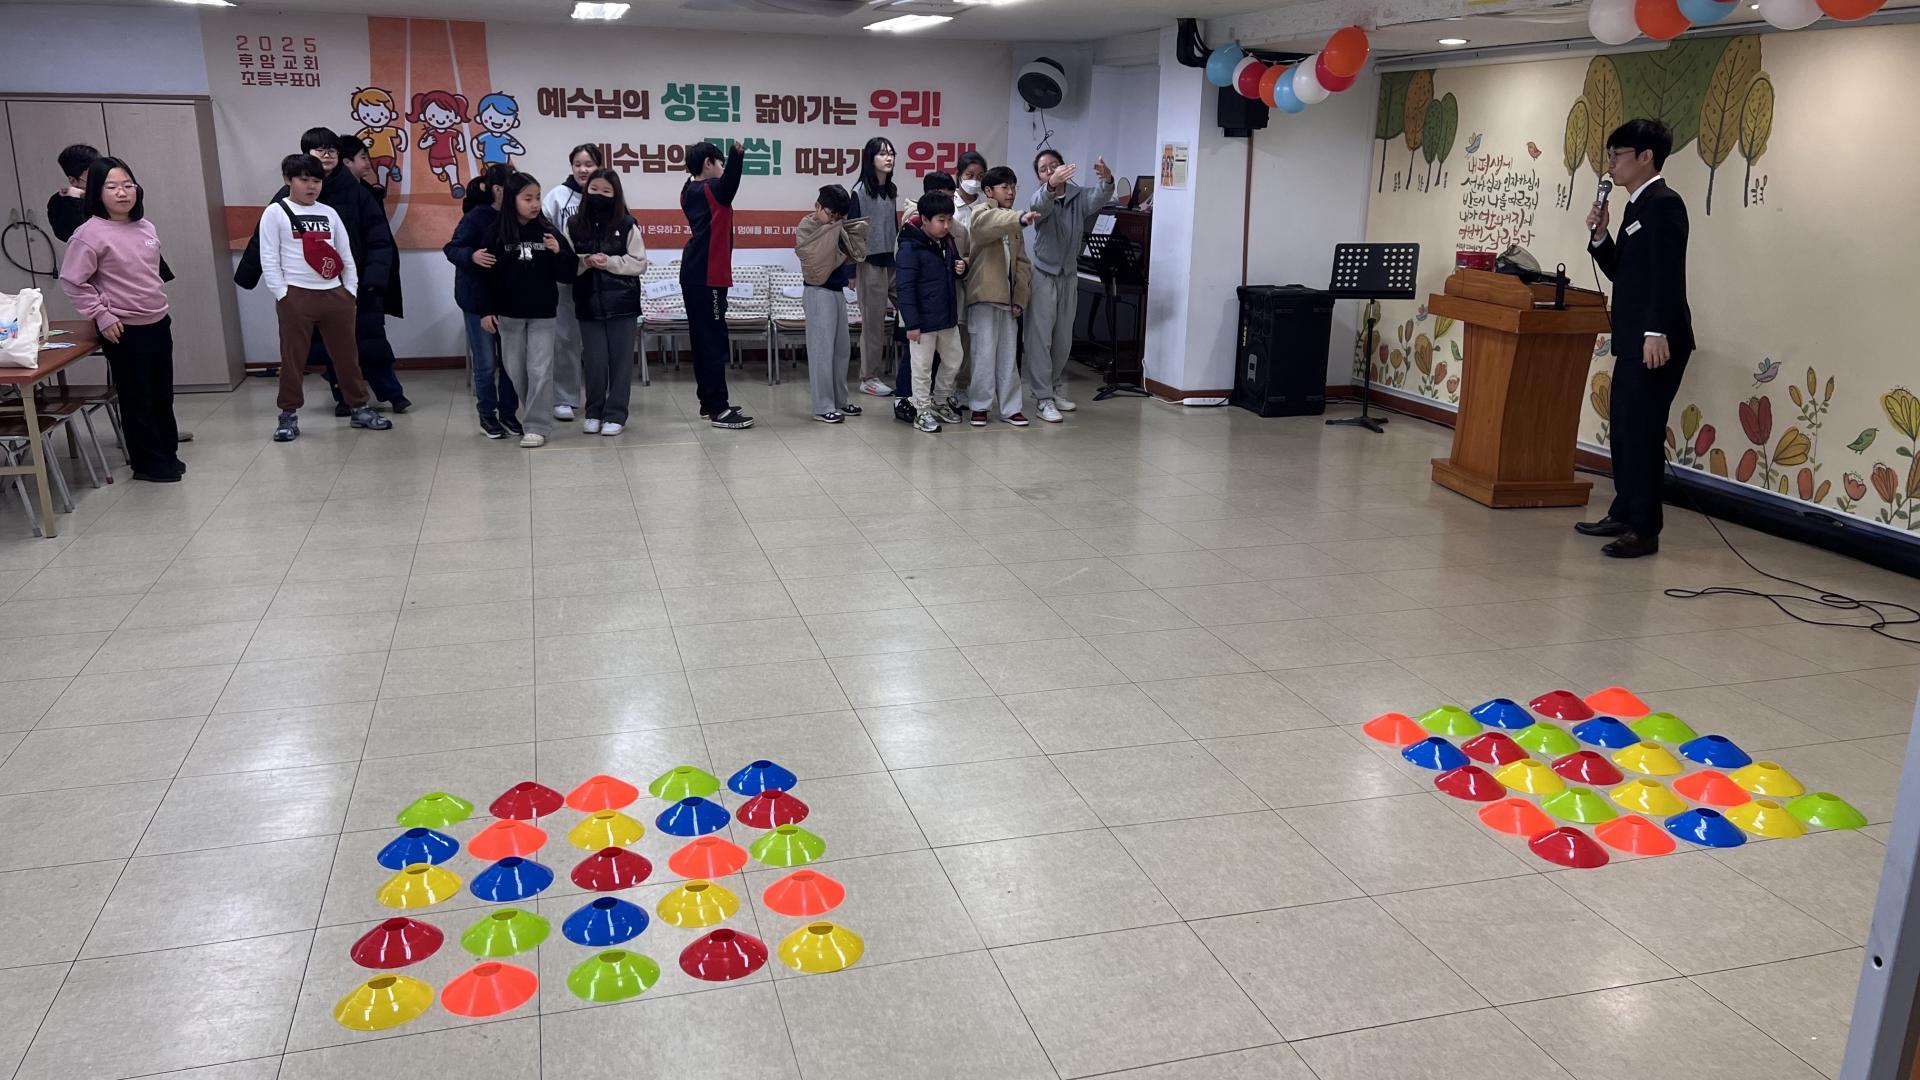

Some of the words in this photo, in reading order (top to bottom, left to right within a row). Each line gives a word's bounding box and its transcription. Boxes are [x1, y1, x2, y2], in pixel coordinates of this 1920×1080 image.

[235, 35, 317, 53] 2025
[238, 53, 319, 70] 후암교회
[241, 71, 320, 87] 초등부표어
[537, 87, 650, 119] 예수님의
[661, 82, 741, 122] 성품!
[755, 94, 857, 125] 닮아가는
[868, 89, 941, 127] 우리!
[1468, 156, 1476, 174] 내
[1477, 153, 1513, 176] 평생에
[647, 225, 681, 235] 온유하고
[737, 225, 762, 235] 멍에를
